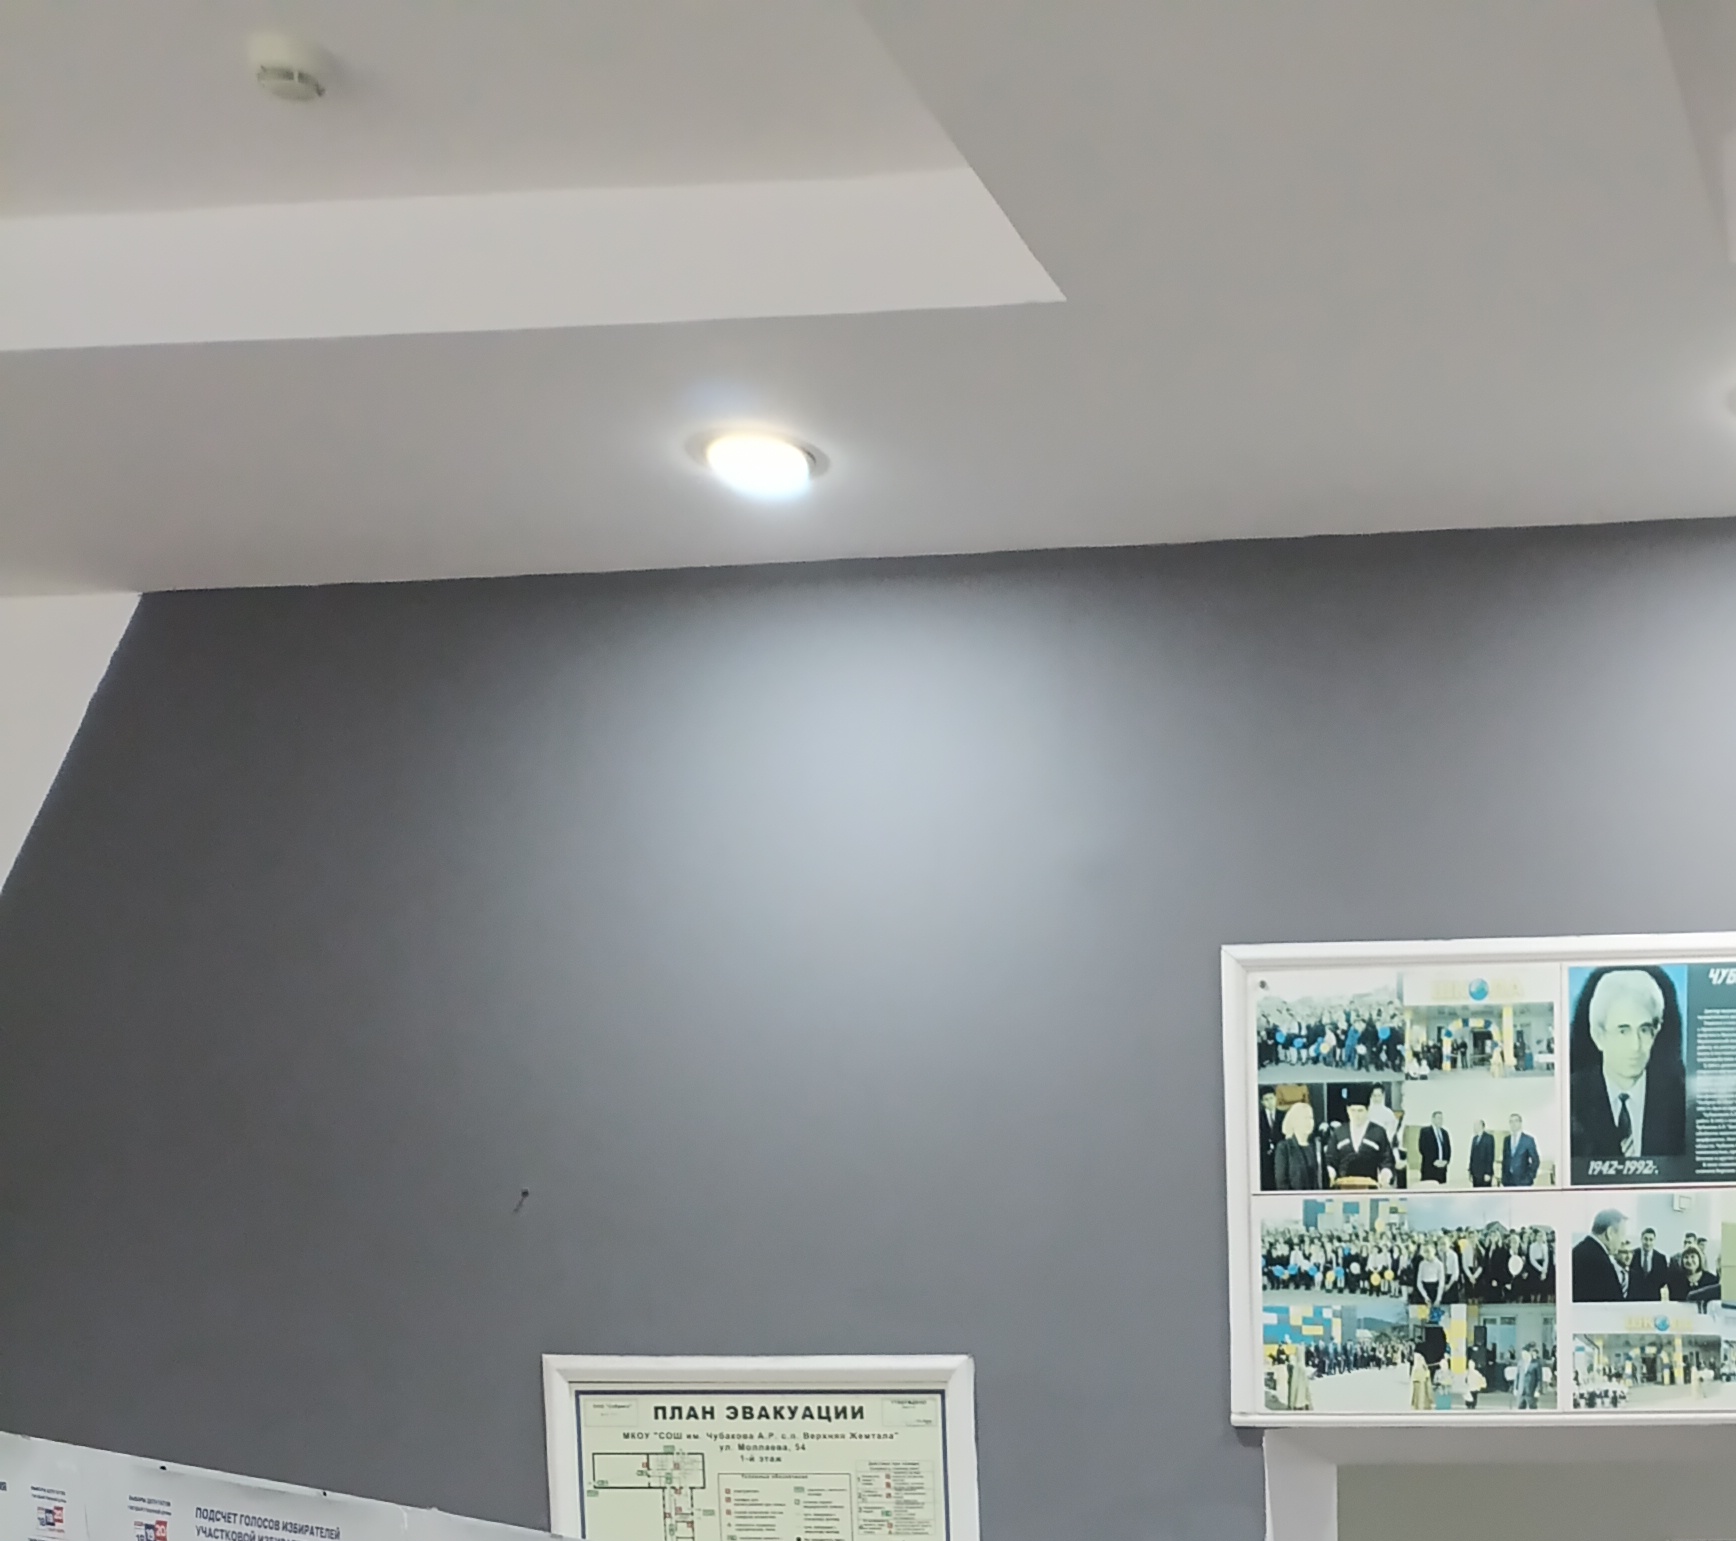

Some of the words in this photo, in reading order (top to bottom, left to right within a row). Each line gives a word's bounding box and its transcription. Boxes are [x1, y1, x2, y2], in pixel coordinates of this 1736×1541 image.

[653, 1405, 716, 1421] ПЛАН
[725, 1404, 865, 1423] ЭВАКУАЦИИ
[623, 1432, 651, 1440] МКОУ
[706, 1432, 755, 1442] Чубакова
[803, 1432, 846, 1442] Верхняя
[195, 1507, 238, 1525] ПОДСЧЕТ
[239, 1513, 280, 1531] ГОЛОСОВ
[282, 1519, 341, 1541] ИЗБИРАТЕЛЕЙ
